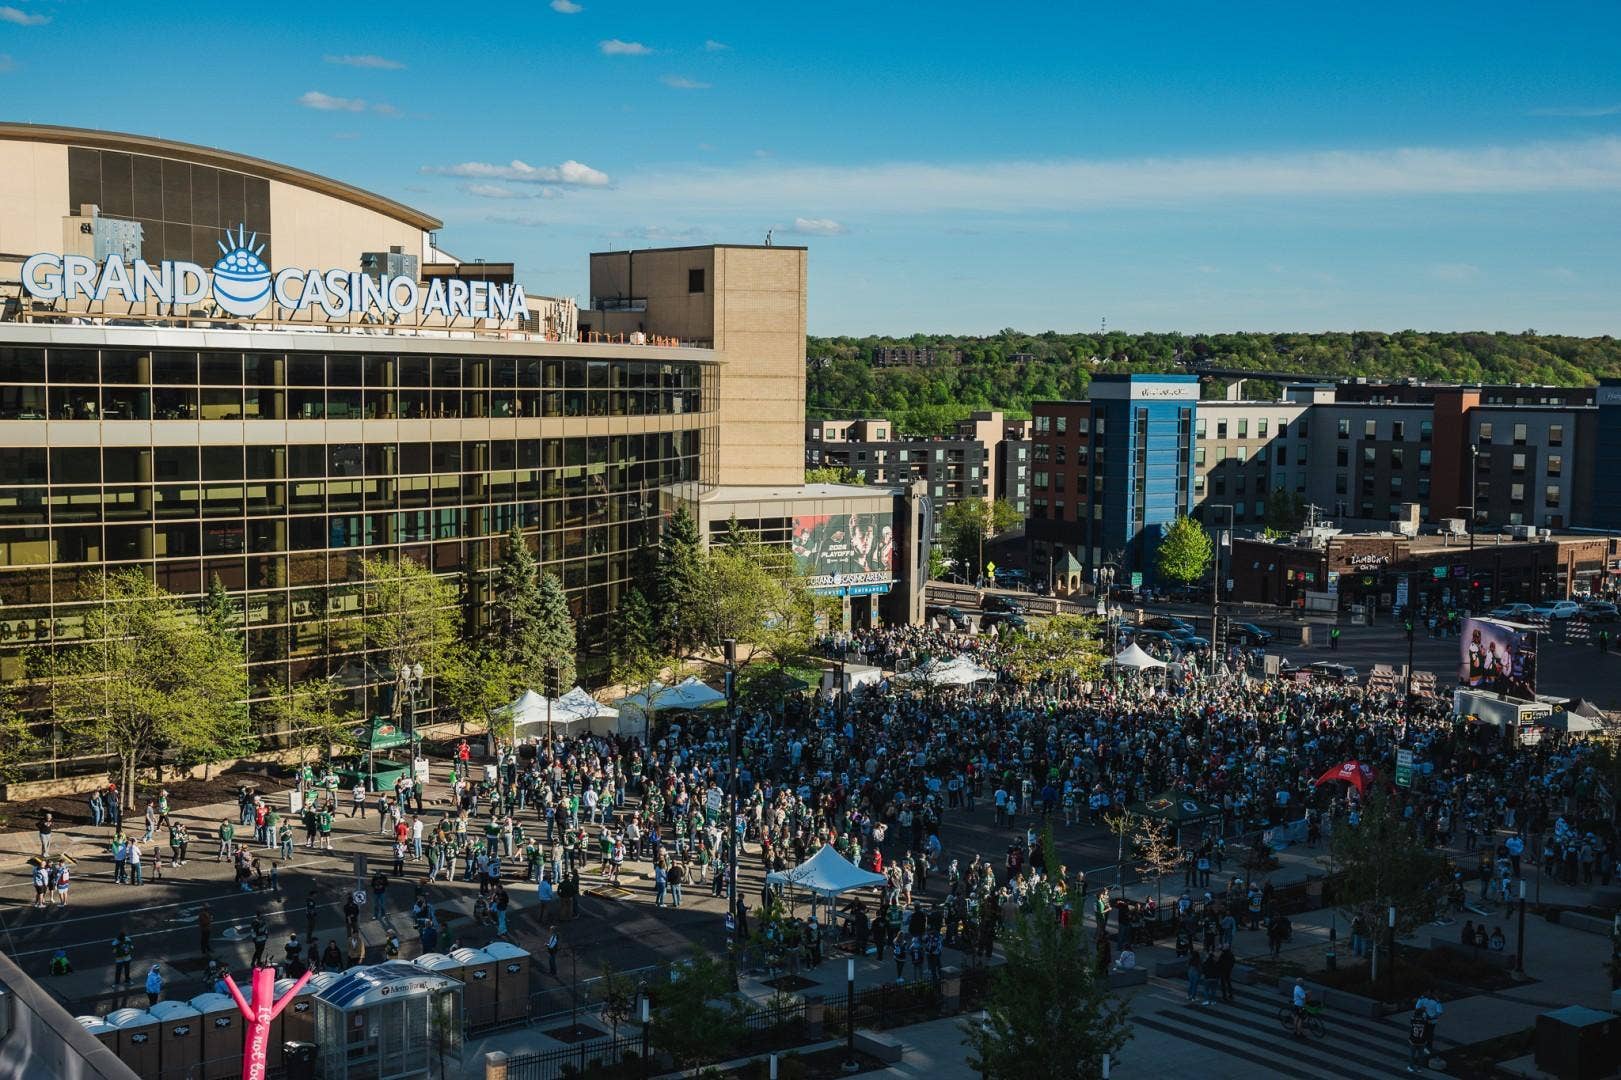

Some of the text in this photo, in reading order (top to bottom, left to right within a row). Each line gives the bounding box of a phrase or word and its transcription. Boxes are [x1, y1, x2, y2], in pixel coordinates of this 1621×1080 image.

[21, 253, 531, 320] GRAND CASINO ARENA
[866, 572, 888, 582] ARENA
[1413, 1027, 1424, 1039] 97
[251, 1036, 265, 1061] not
